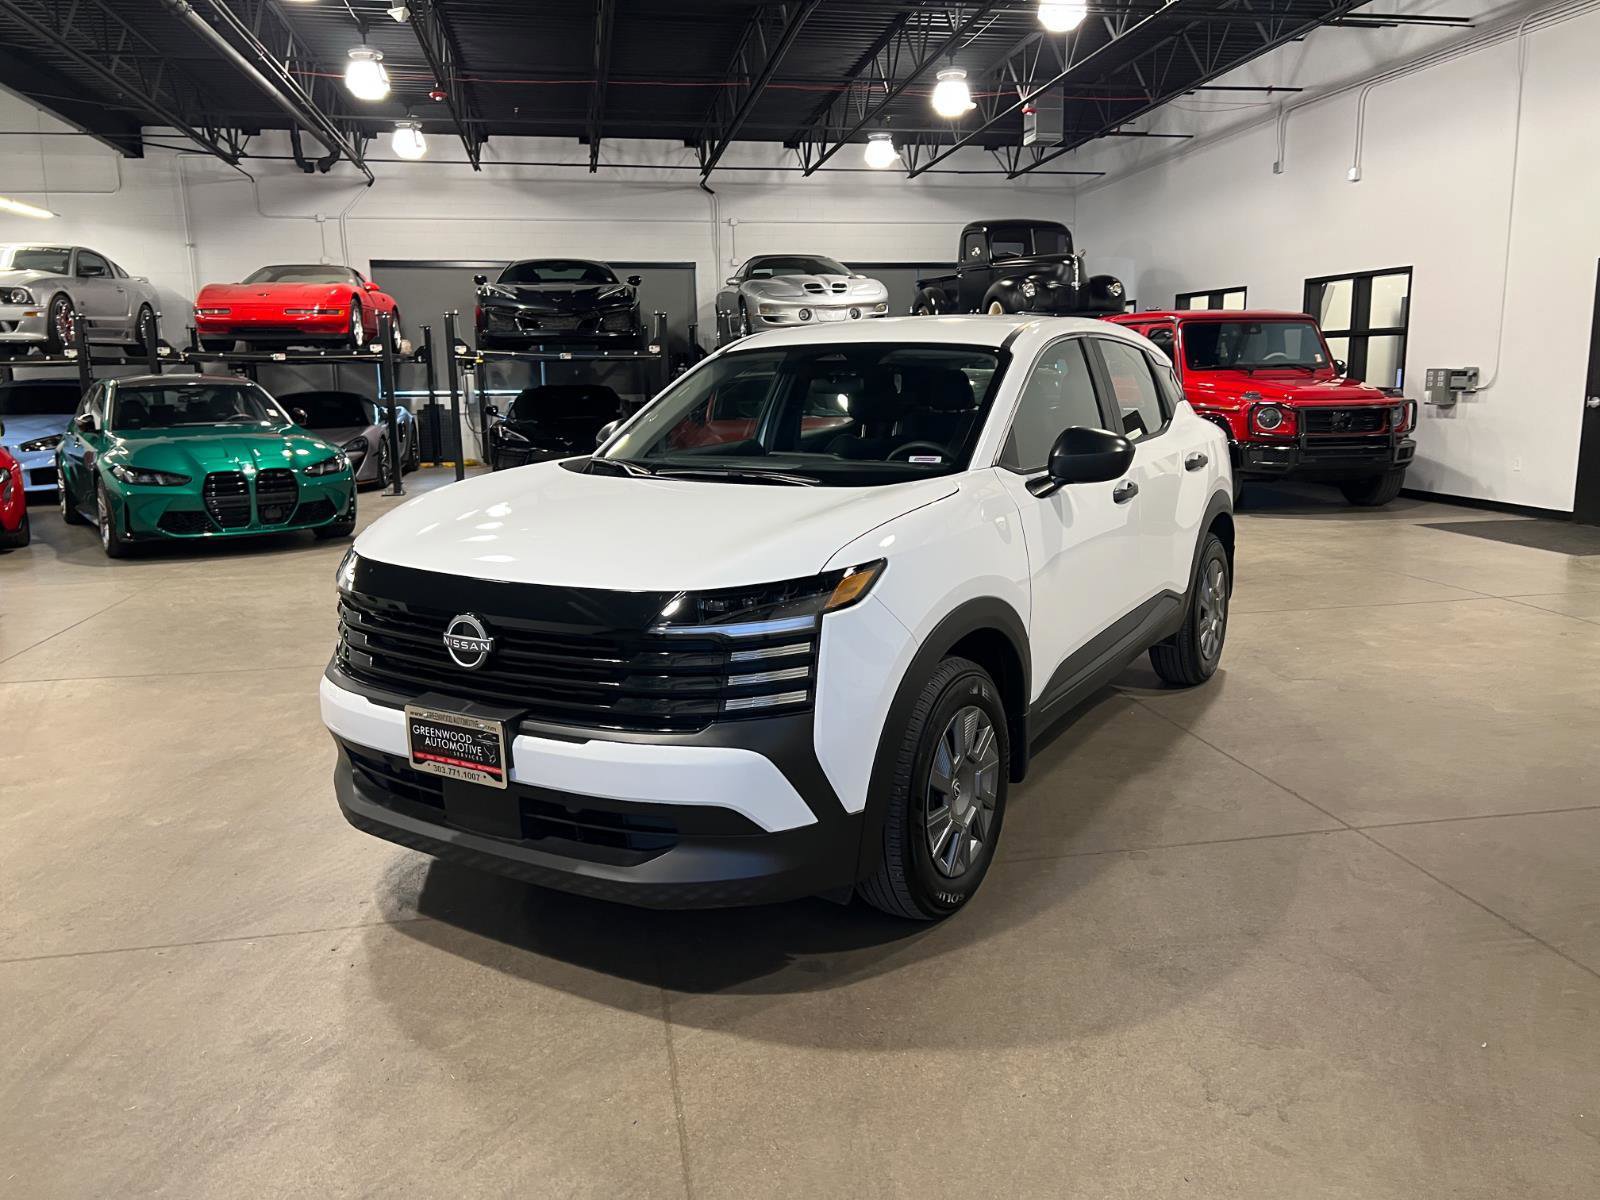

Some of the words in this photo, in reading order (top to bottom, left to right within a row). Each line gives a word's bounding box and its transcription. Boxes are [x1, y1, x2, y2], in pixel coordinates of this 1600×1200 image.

[443, 635, 490, 651] NISSAN
[412, 725, 473, 744] GREENWOOD
[424, 737, 482, 756] AUTOMOTIVE
[453, 752, 484, 762] SERVICES
[433, 765, 481, 781] 303.771.1007
